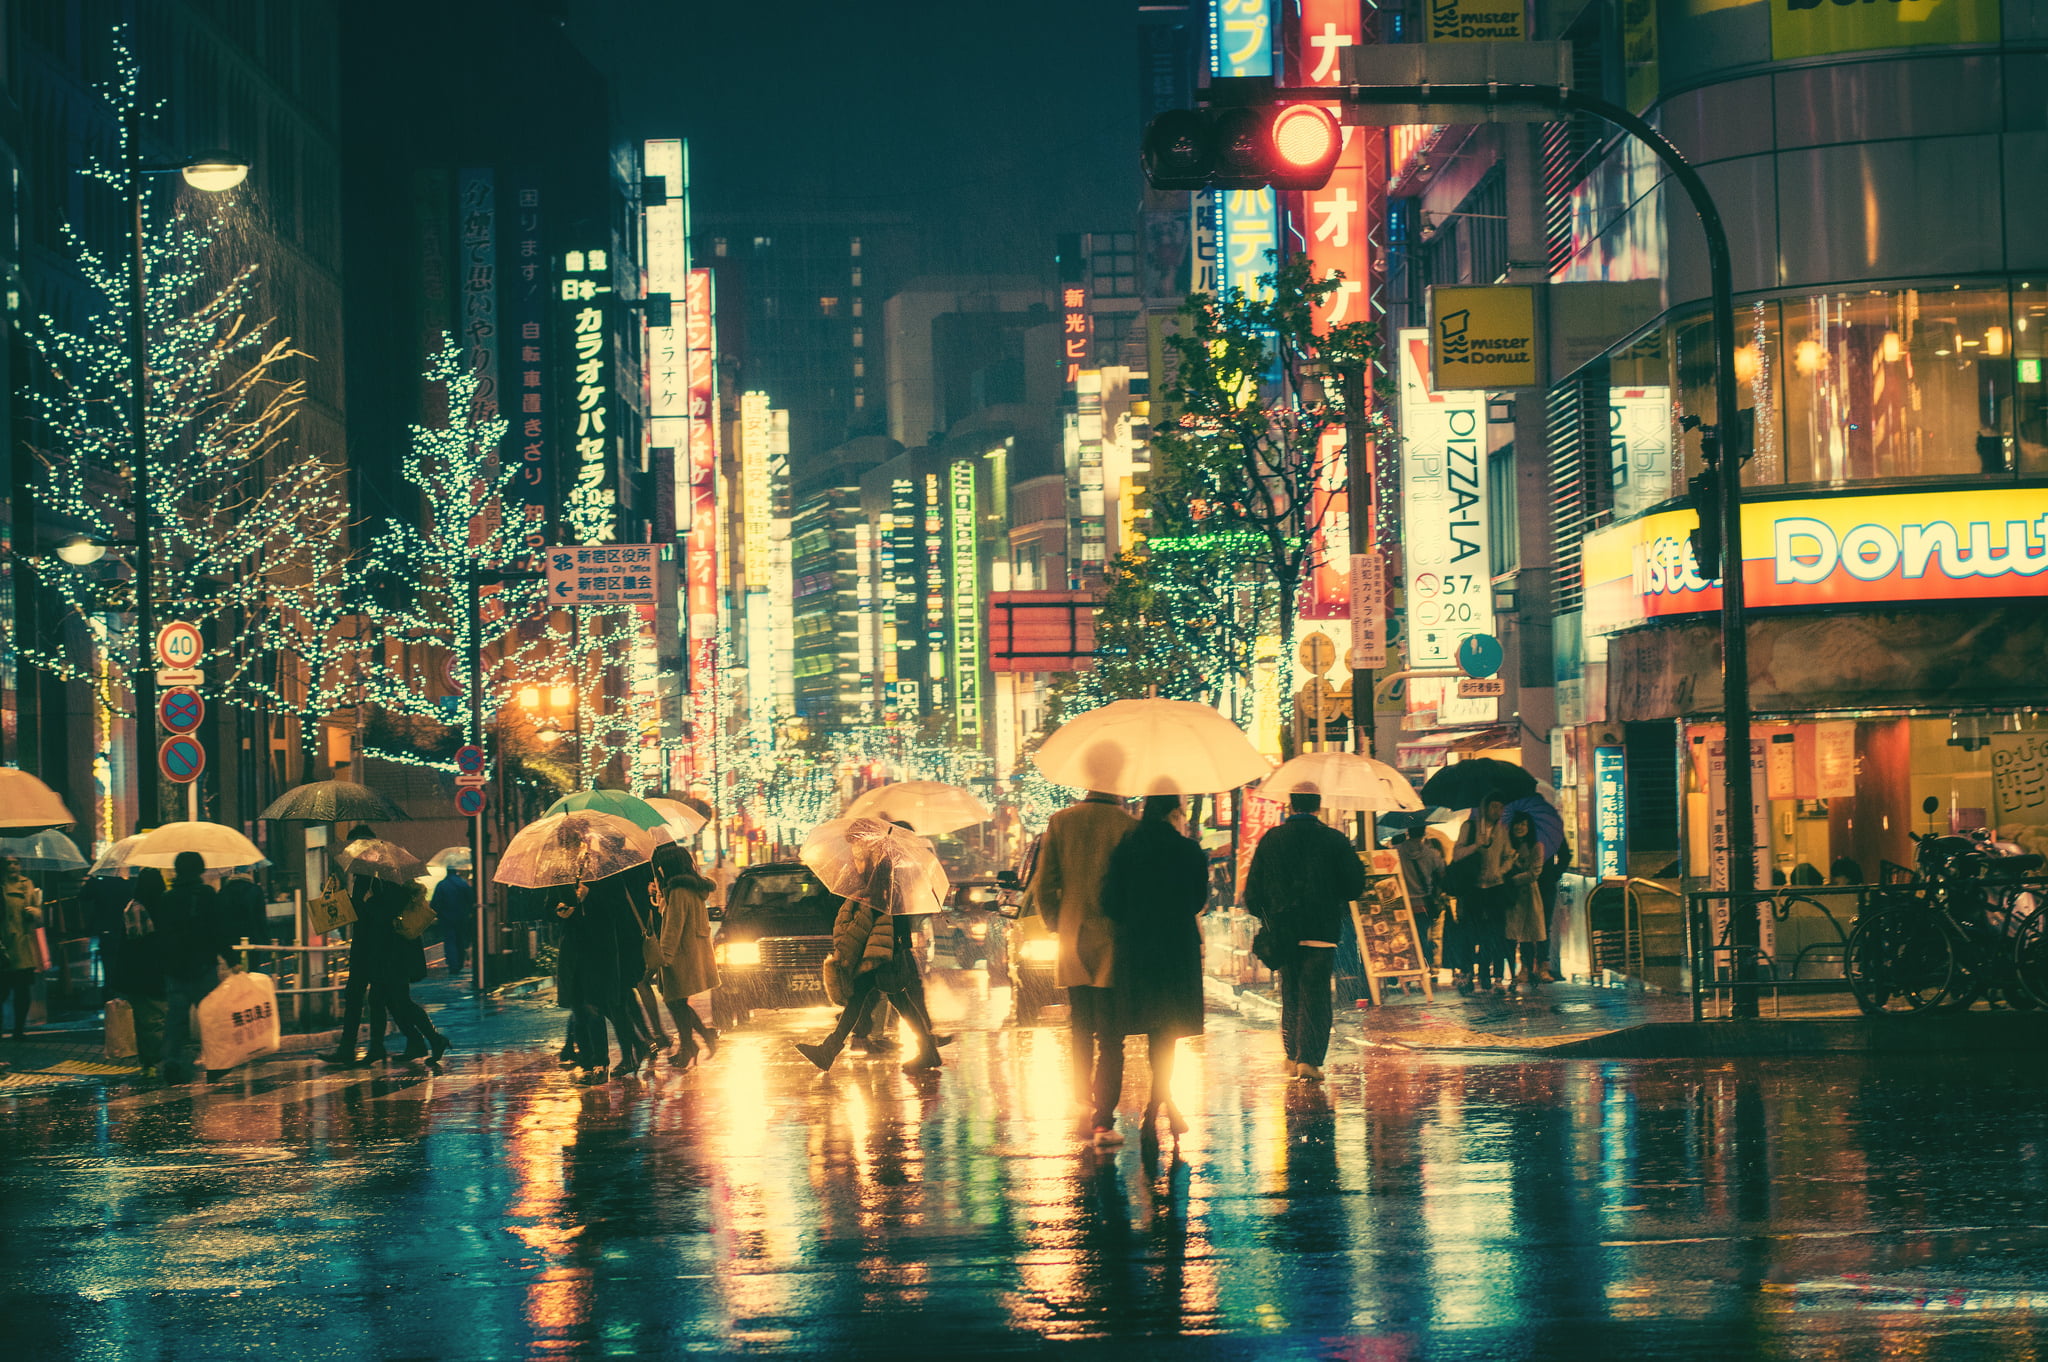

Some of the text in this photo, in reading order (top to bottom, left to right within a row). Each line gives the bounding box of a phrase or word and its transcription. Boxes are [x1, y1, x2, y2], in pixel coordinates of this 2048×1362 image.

[1460, 26, 1520, 38] Donut
[1470, 337, 1531, 350] mister
[1470, 352, 1532, 364] Donut
[575, 307, 606, 491] カラオケパセラ
[577, 548, 651, 563] 新宿区役所
[611, 565, 626, 574] City
[607, 593, 619, 601] City
[169, 636, 192, 656] 40
